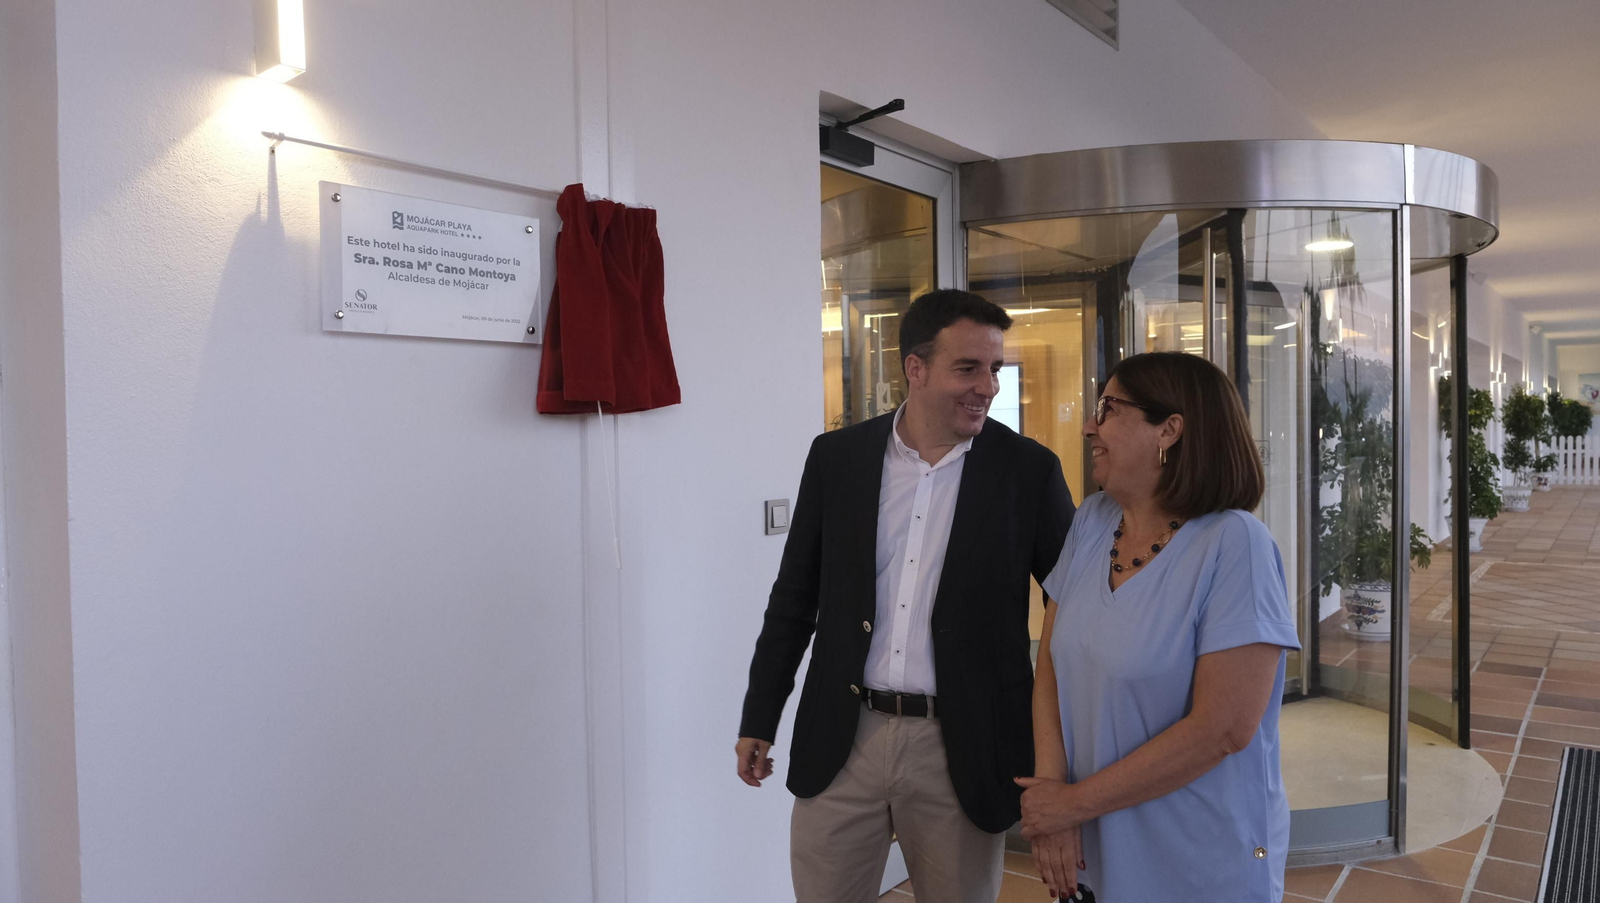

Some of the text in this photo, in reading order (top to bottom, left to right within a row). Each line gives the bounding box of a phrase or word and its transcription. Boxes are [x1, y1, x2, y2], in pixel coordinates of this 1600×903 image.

[406, 215, 473, 232] MOJÁCAR PLAYA
[406, 224, 459, 237] AQUAPARK HOTEL
[347, 235, 521, 266] Este hotel ha sido inaugurado por la
[354, 252, 516, 283] Sra. Rosa Mª Cano Montoya
[388, 271, 489, 291] Alcaldesa de Mojácar
[344, 301, 378, 311] SENATOR
